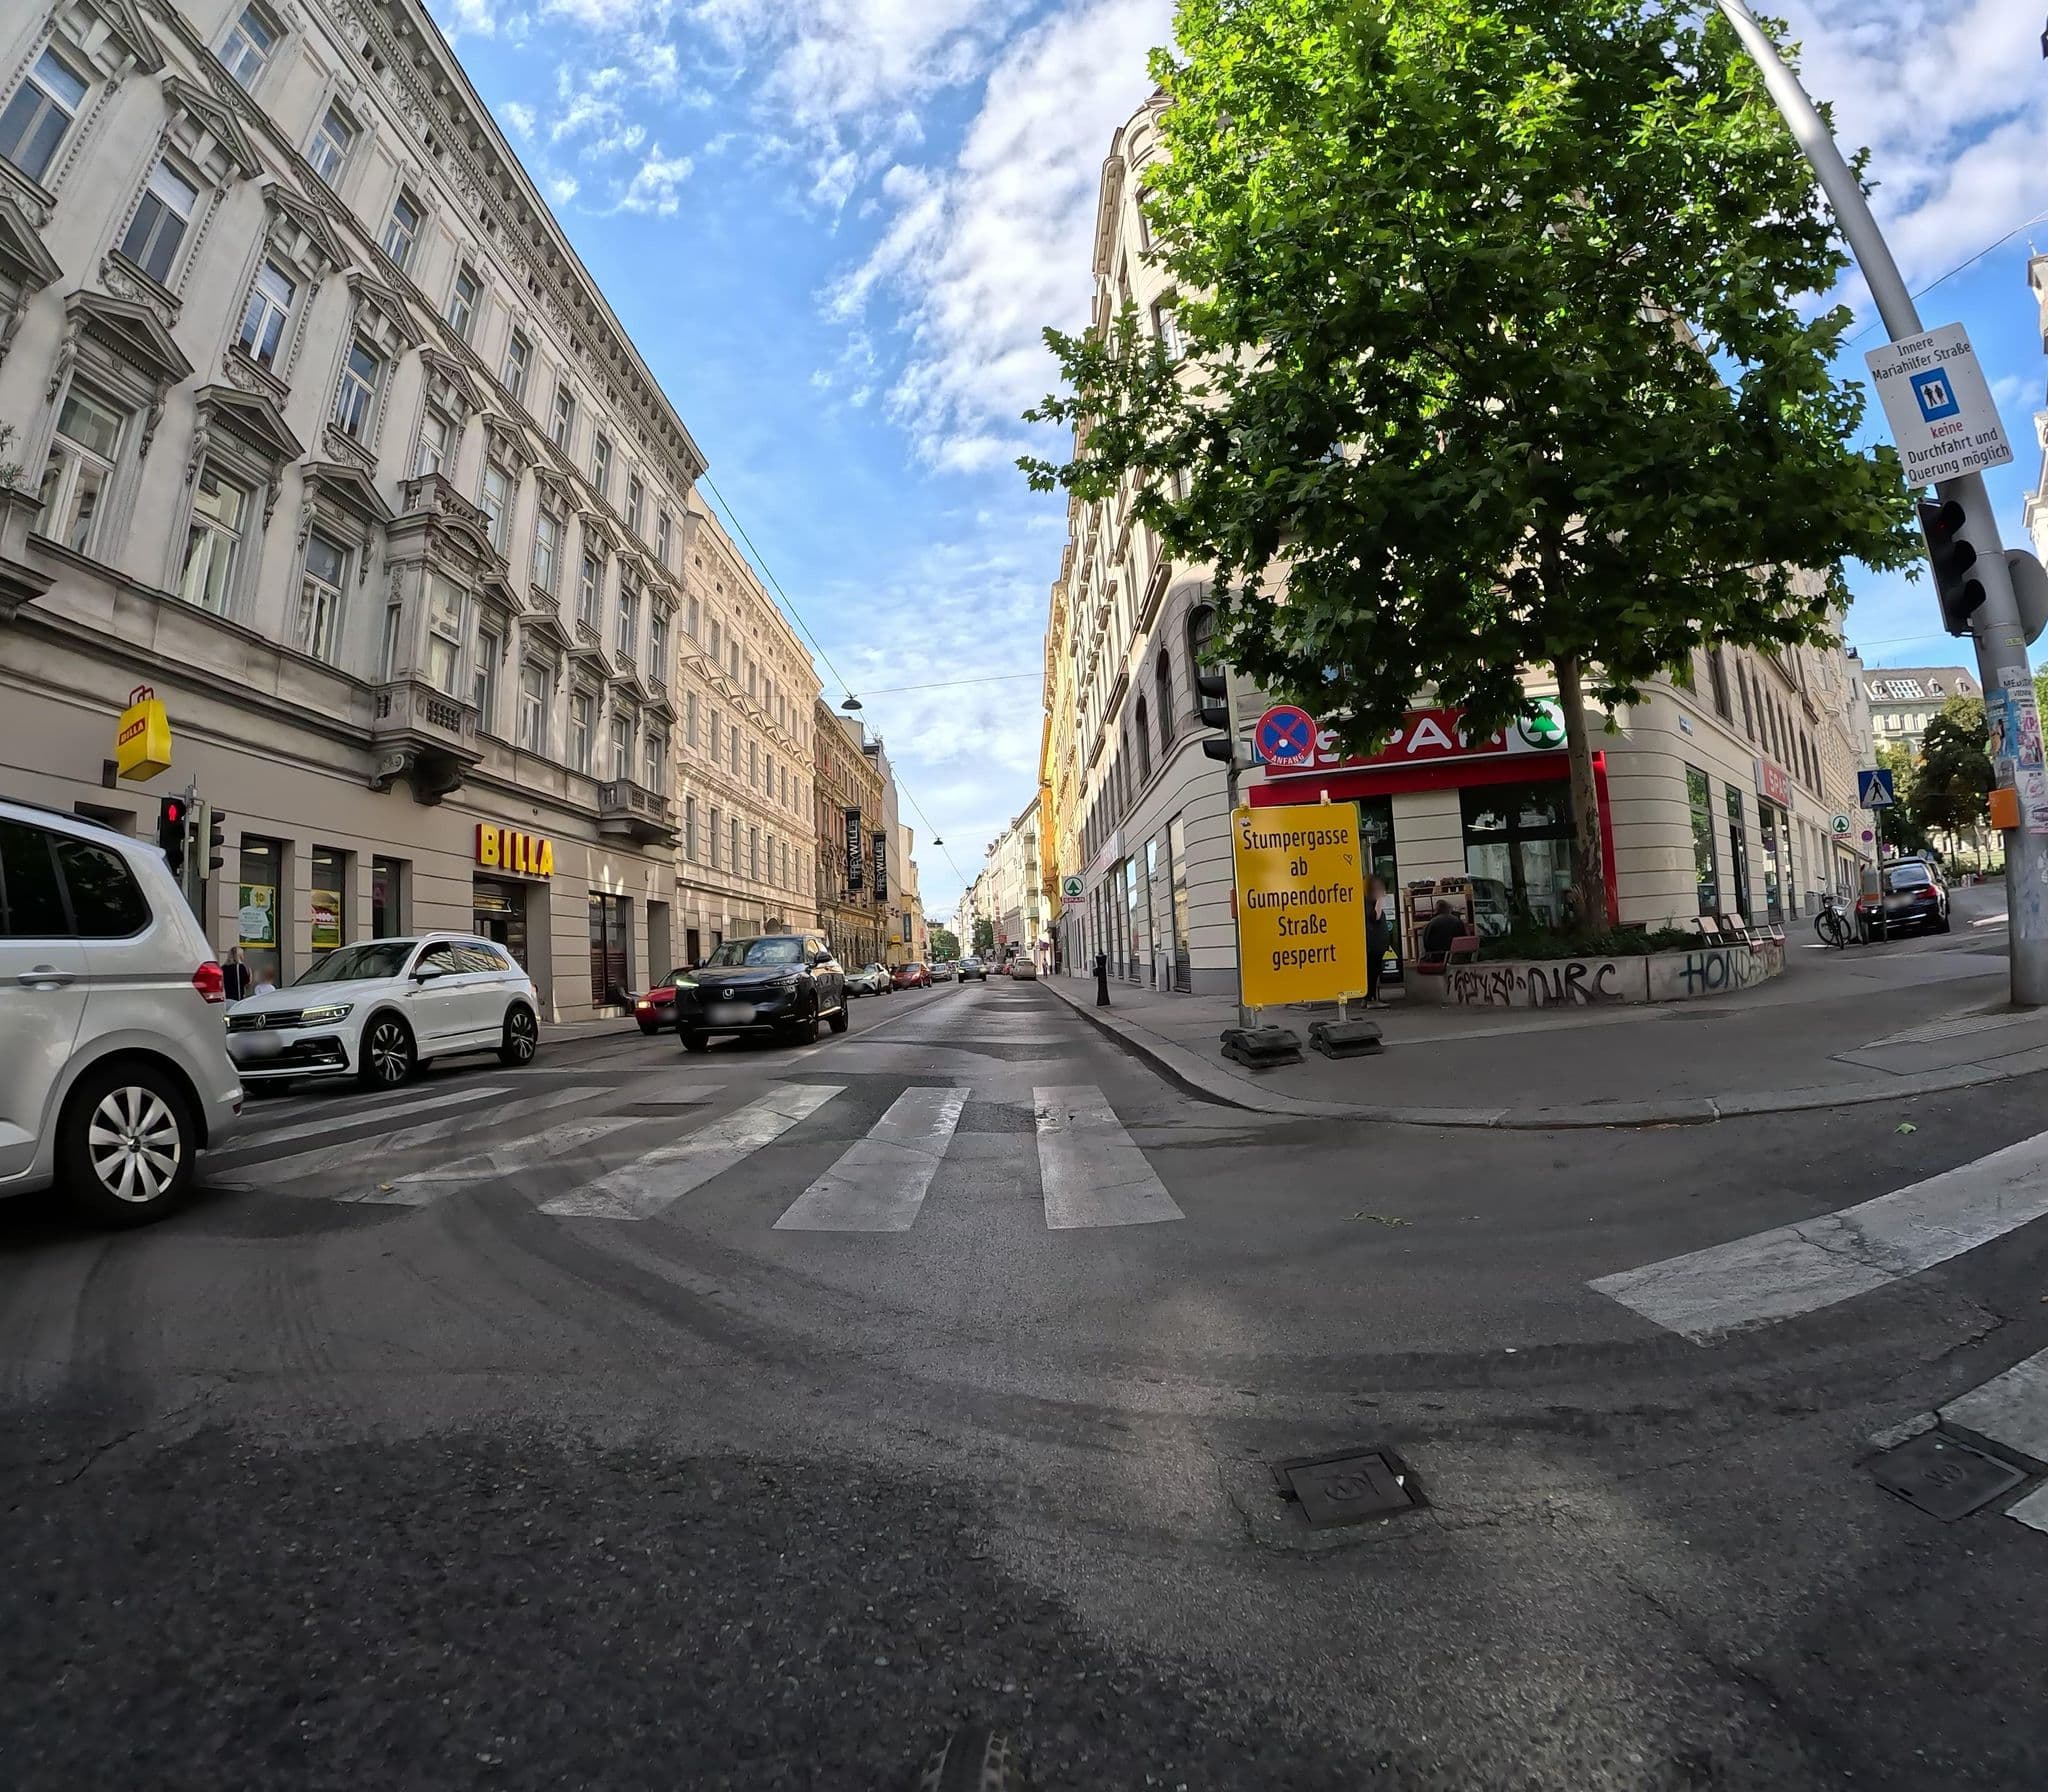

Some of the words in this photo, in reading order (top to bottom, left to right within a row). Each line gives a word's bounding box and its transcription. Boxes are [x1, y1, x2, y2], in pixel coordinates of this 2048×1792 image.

[1897, 337, 1934, 357] Innere
[1872, 356, 1933, 381] Mariahilfer
[1936, 342, 1971, 361] Straße
[1930, 420, 1964, 440] keine
[1908, 438, 1973, 463] Durchfahrt
[1976, 427, 1999, 446] und
[1908, 459, 1960, 483] Querung
[1963, 444, 2011, 468] möglich
[121, 722, 144, 743] BILLA
[1271, 752, 1305, 765] ANFANG
[476, 824, 555, 877] BILLA
[848, 820, 859, 879] FREYWILLE
[1243, 829, 1348, 852] Stumpergasse
[1290, 857, 1308, 876] ab
[1247, 883, 1353, 911] Gumpendorfer
[1278, 914, 1327, 936] Straße
[1272, 944, 1336, 971] gesperrt
